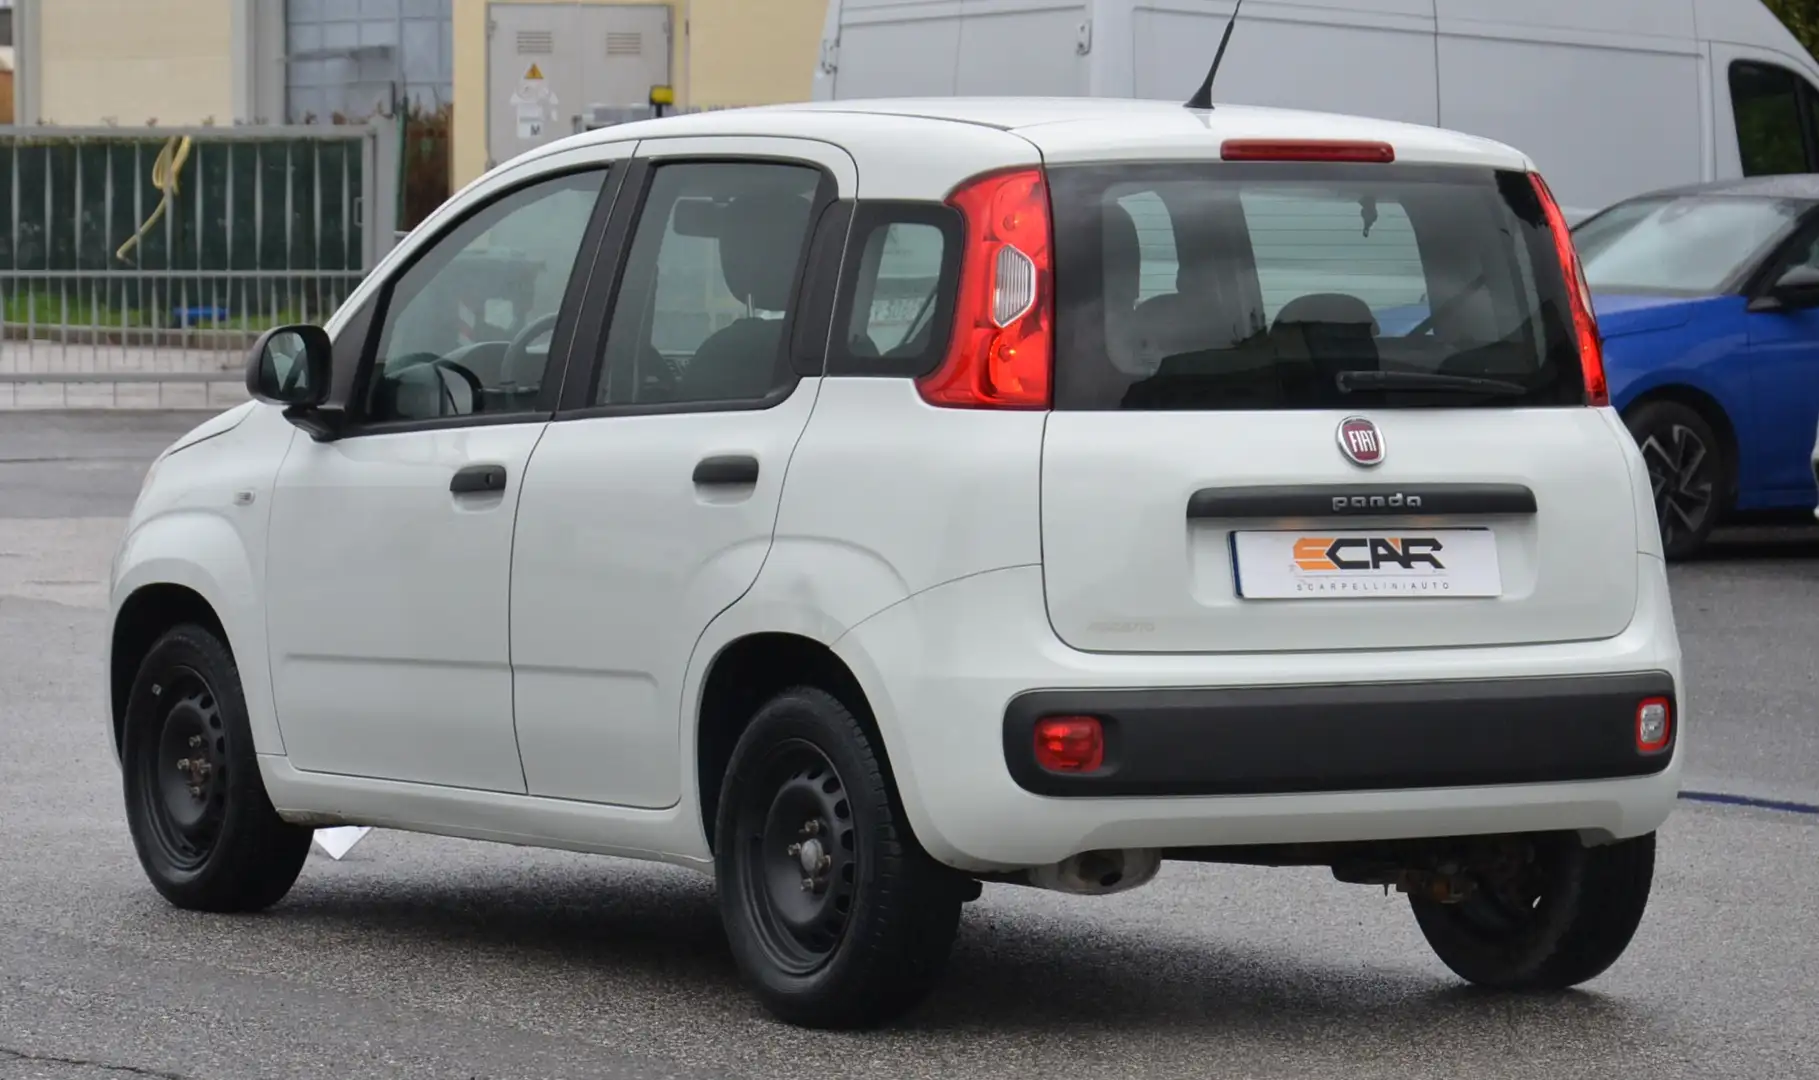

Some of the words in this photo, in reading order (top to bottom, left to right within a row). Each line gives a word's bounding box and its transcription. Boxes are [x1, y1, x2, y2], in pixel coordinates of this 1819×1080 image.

[1348, 430, 1377, 452] FIAT
[1332, 493, 1422, 510] panda
[1297, 582, 1450, 592] SCARPELLINIAUTO
